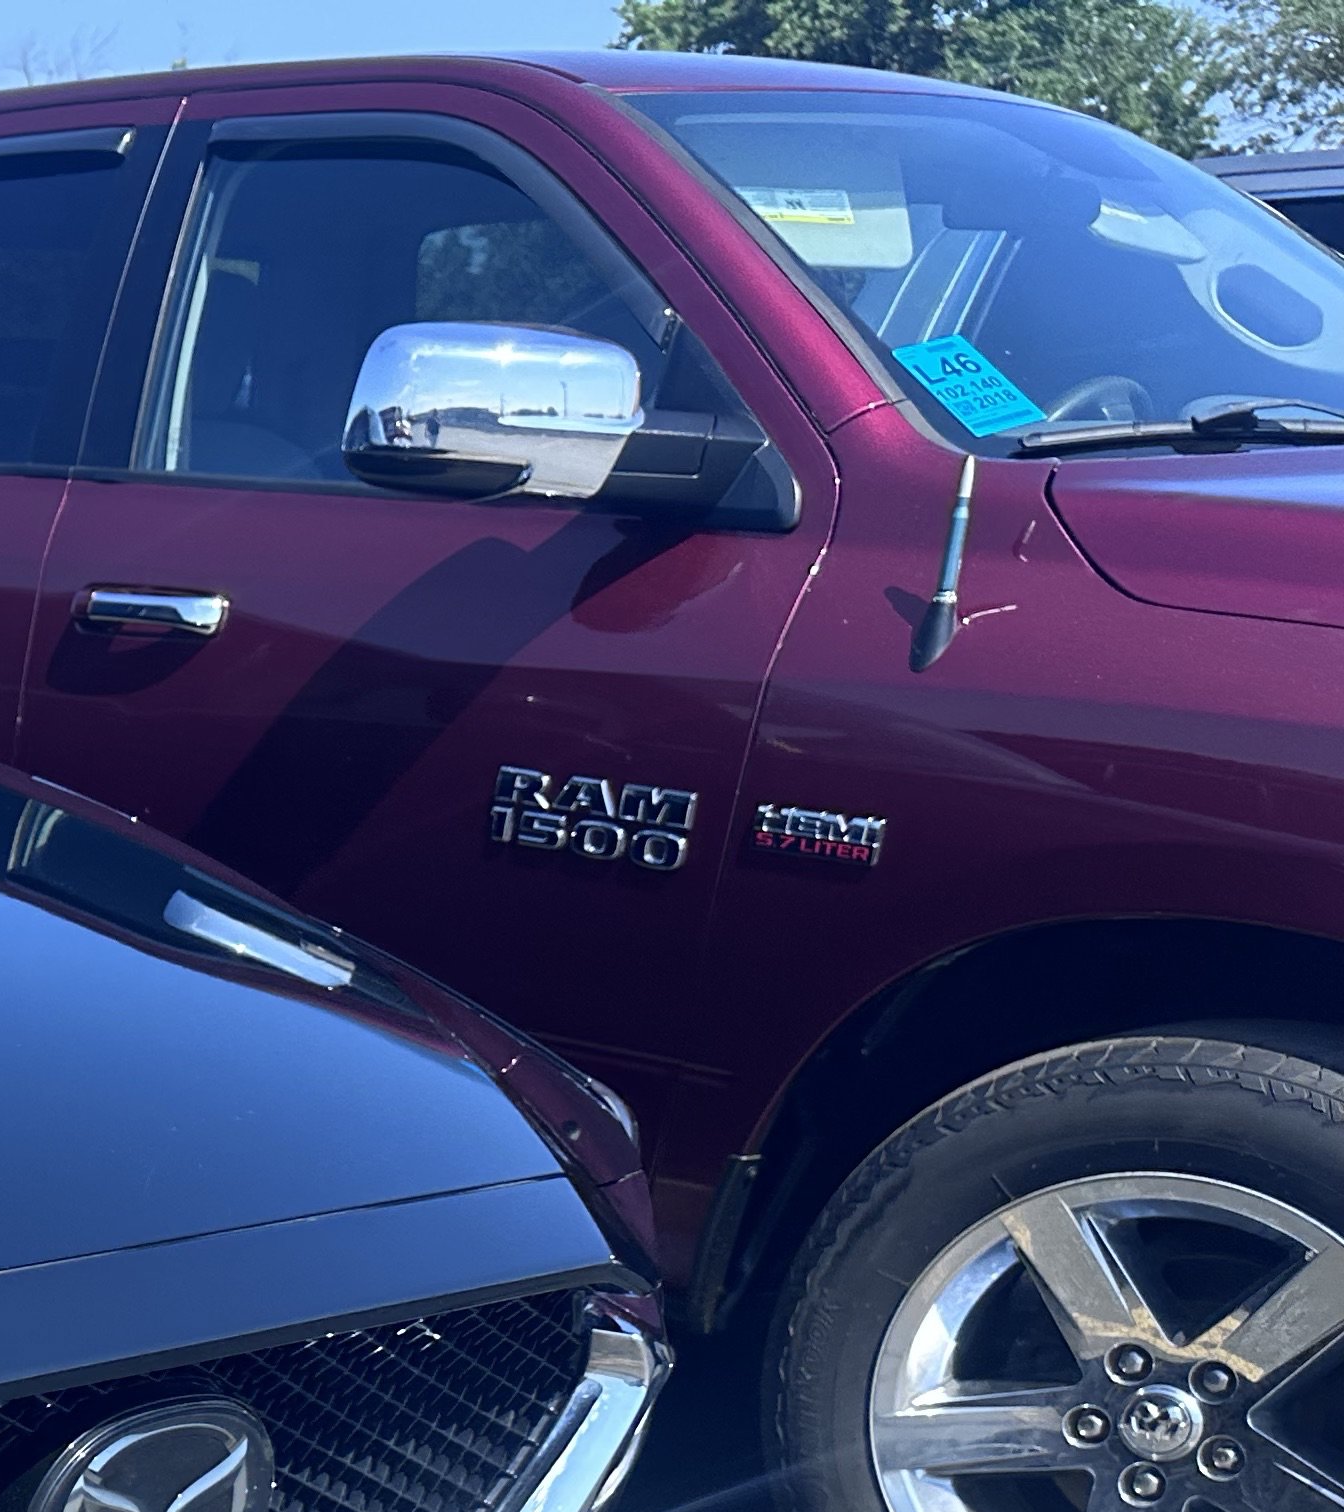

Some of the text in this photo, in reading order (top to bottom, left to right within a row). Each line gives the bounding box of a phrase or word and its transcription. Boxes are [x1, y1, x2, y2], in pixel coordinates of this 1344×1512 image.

[913, 352, 982, 385] L46
[936, 375, 1002, 402] 102,140
[974, 389, 1017, 409] 2018
[493, 764, 700, 829] RAM
[490, 805, 691, 871] 1500
[755, 803, 888, 845] HEMI
[799, 839, 870, 861] LITER
